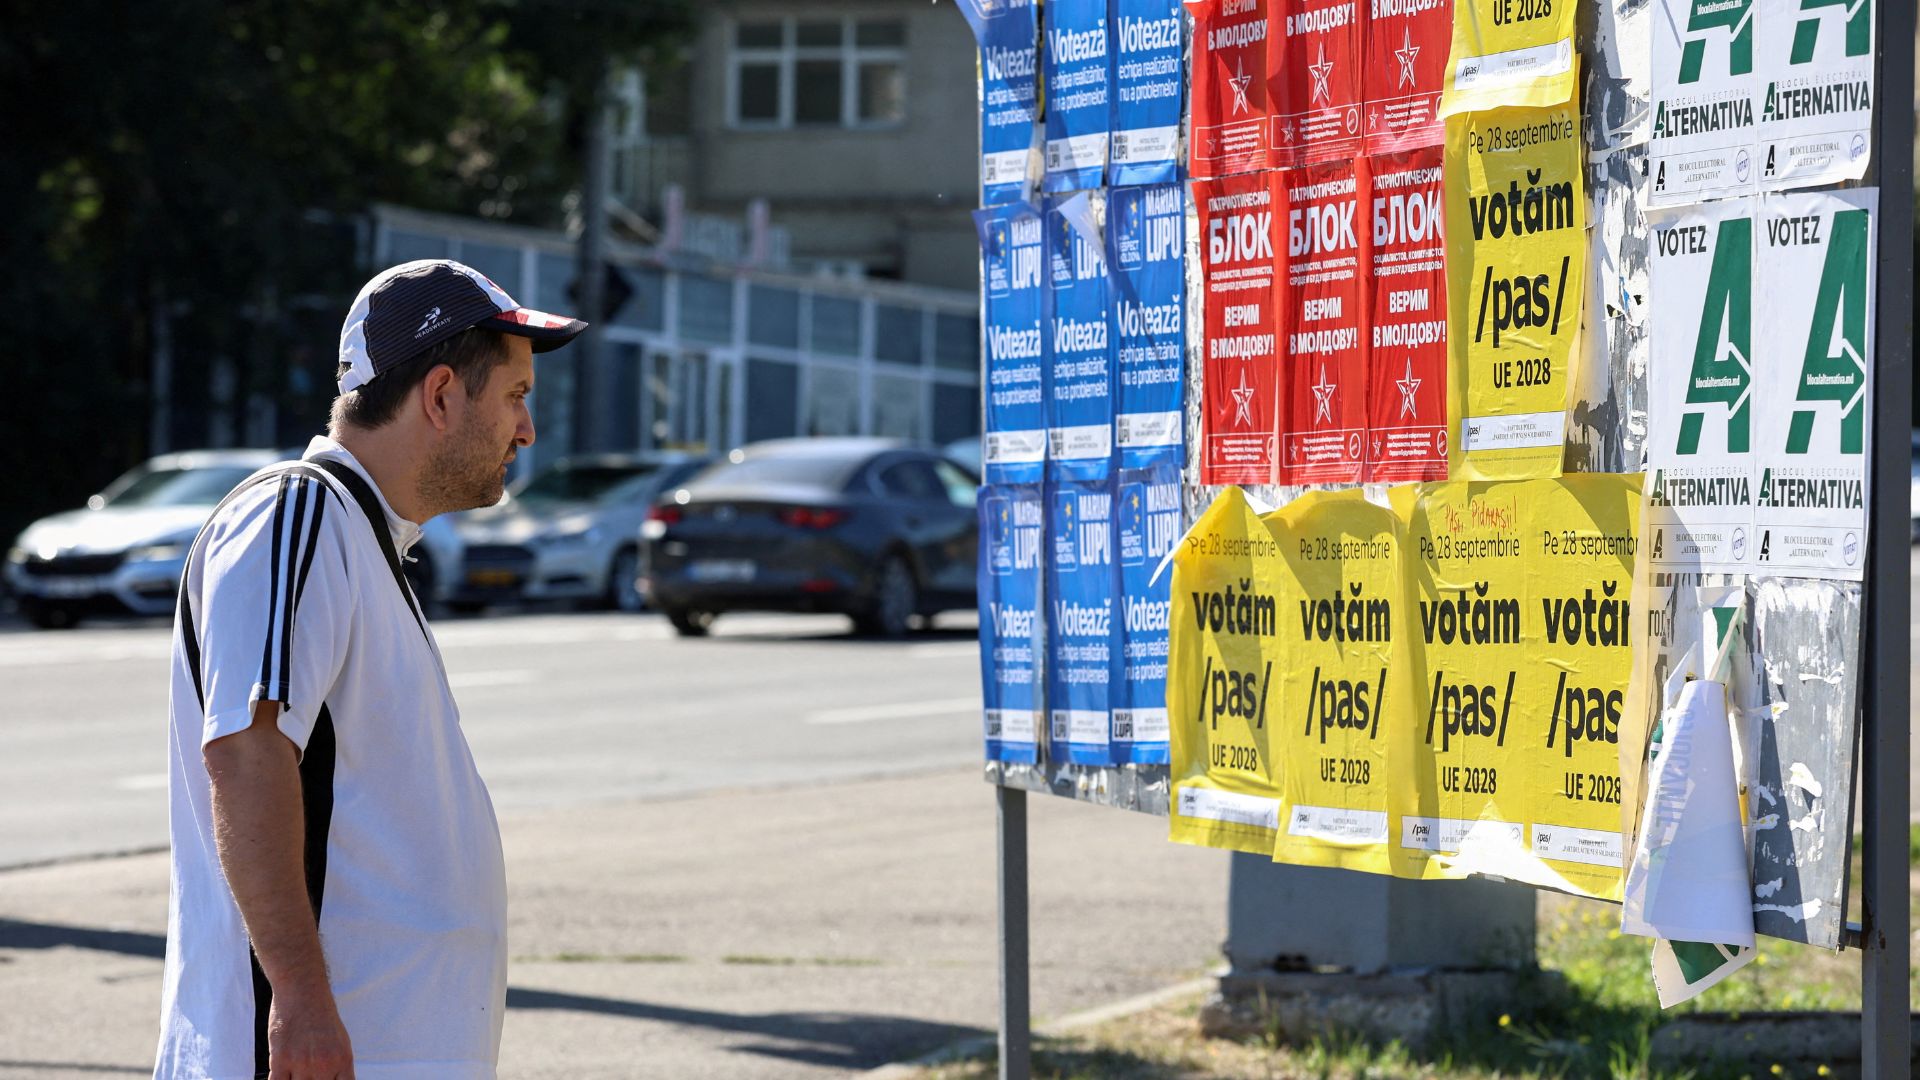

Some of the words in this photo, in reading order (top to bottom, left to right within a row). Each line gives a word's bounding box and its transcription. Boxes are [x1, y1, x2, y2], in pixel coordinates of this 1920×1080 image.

[1222, 0, 1256, 17] ВЕРИМ
[1287, 16, 1294, 36] В
[1296, 2, 1356, 34] МОЛДОВУ!
[1494, 0, 1512, 26] UE
[1517, 0, 1552, 22] 2028
[1048, 19, 1106, 65] Votează
[1118, 8, 1180, 53] Votează
[1208, 31, 1215, 51] В
[1216, 19, 1267, 49] МОЛДОВУ
[1119, 60, 1142, 81] echipa
[1776, 77, 1809, 89] BLOCUL
[1815, 71, 1867, 84] ELECTORAL
[1119, 87, 1130, 101] nu
[1665, 96, 1697, 108] BLOCUL
[1702, 87, 1751, 103] ELECTORAL
[1762, 80, 1870, 122] ALTERNATIVA
[1652, 97, 1754, 139] ALTERNATIVA
[1470, 132, 1483, 155] Pe
[1487, 127, 1502, 153] 28
[1505, 114, 1573, 153] septembrie
[1656, 161, 1665, 191] A
[1765, 144, 1775, 176] A
[1145, 187, 1181, 216] MARIAN
[1209, 188, 1271, 212] ПАТРИОТИЧЕСКИЙ
[1289, 174, 1356, 202] ПАТРИОТИЧЕСКИЙ
[1373, 189, 1443, 247] БЛОК
[1469, 168, 1574, 241] votăm
[1146, 215, 1181, 262] LUPU
[1209, 211, 1273, 264] БЛОК
[1289, 200, 1358, 257] БЛОК
[1657, 225, 1706, 257] VOTEZ
[1767, 215, 1821, 247] VOTEZ
[1012, 246, 1041, 289] LUPU
[1117, 295, 1180, 337] Votează
[1224, 304, 1259, 327] ВЕРИМ
[1304, 297, 1342, 321] ВЕРИМ
[1389, 288, 1428, 313] ВЕРИМ
[1475, 256, 1570, 348] /pas/
[988, 320, 1041, 360] Votează
[1052, 311, 1107, 353] Votează
[1211, 338, 1218, 359] В
[1219, 334, 1274, 360] МОЛДОВУ!
[1290, 335, 1296, 355] В
[1298, 327, 1357, 355] МОЛДОВУ!
[1373, 327, 1380, 347] В
[1382, 321, 1445, 348] МОЛДОВУ!
[1119, 344, 1144, 366] echipa
[1121, 371, 1131, 385] nu
[1132, 371, 1137, 385] a
[1494, 361, 1511, 389] UE
[1517, 357, 1551, 387] 2028
[1650, 468, 1750, 507] ALTERNATIVA
[1664, 468, 1695, 477] BLOCUL
[1772, 467, 1805, 476] BLOCUL
[1147, 483, 1179, 513] MARIAN
[1757, 468, 1863, 509] ALTERNATIVA
[1078, 494, 1111, 521] MARIAN
[1079, 521, 1111, 565] LUPU
[1187, 536, 1206, 554] Pe
[1208, 533, 1221, 555] 28
[1223, 533, 1275, 561] septembrie
[1300, 538, 1312, 560] Pe
[1315, 537, 1328, 560] 28
[1331, 535, 1390, 564] septembrie
[1420, 536, 1433, 560] Pe
[1437, 535, 1451, 559] 28
[1455, 531, 1519, 564] septembrie
[1544, 530, 1558, 555] Pe
[1562, 530, 1576, 556] 28
[1581, 529, 1638, 562] septembr
[1652, 528, 1662, 558] A
[1759, 529, 1770, 561] A
[1055, 598, 1111, 637] Votează
[1122, 595, 1170, 632] Voteaz
[1192, 578, 1276, 636] votăm
[1300, 582, 1390, 642] votăm
[1420, 581, 1520, 645] votăm
[1198, 656, 1272, 730] /pas/
[1305, 666, 1387, 744] /pas/
[1425, 671, 1516, 752] /pas/
[1546, 672, 1622, 757] /pas
[1212, 743, 1226, 767] UE
[1230, 745, 1257, 771] 2028
[1321, 757, 1335, 783] UE
[1340, 759, 1370, 785] 2028
[1443, 766, 1459, 793] UE
[1464, 767, 1497, 794] 2028
[1565, 772, 1583, 800] UE
[1588, 774, 1621, 804] 2028
[1537, 832, 1551, 844] /pas/
